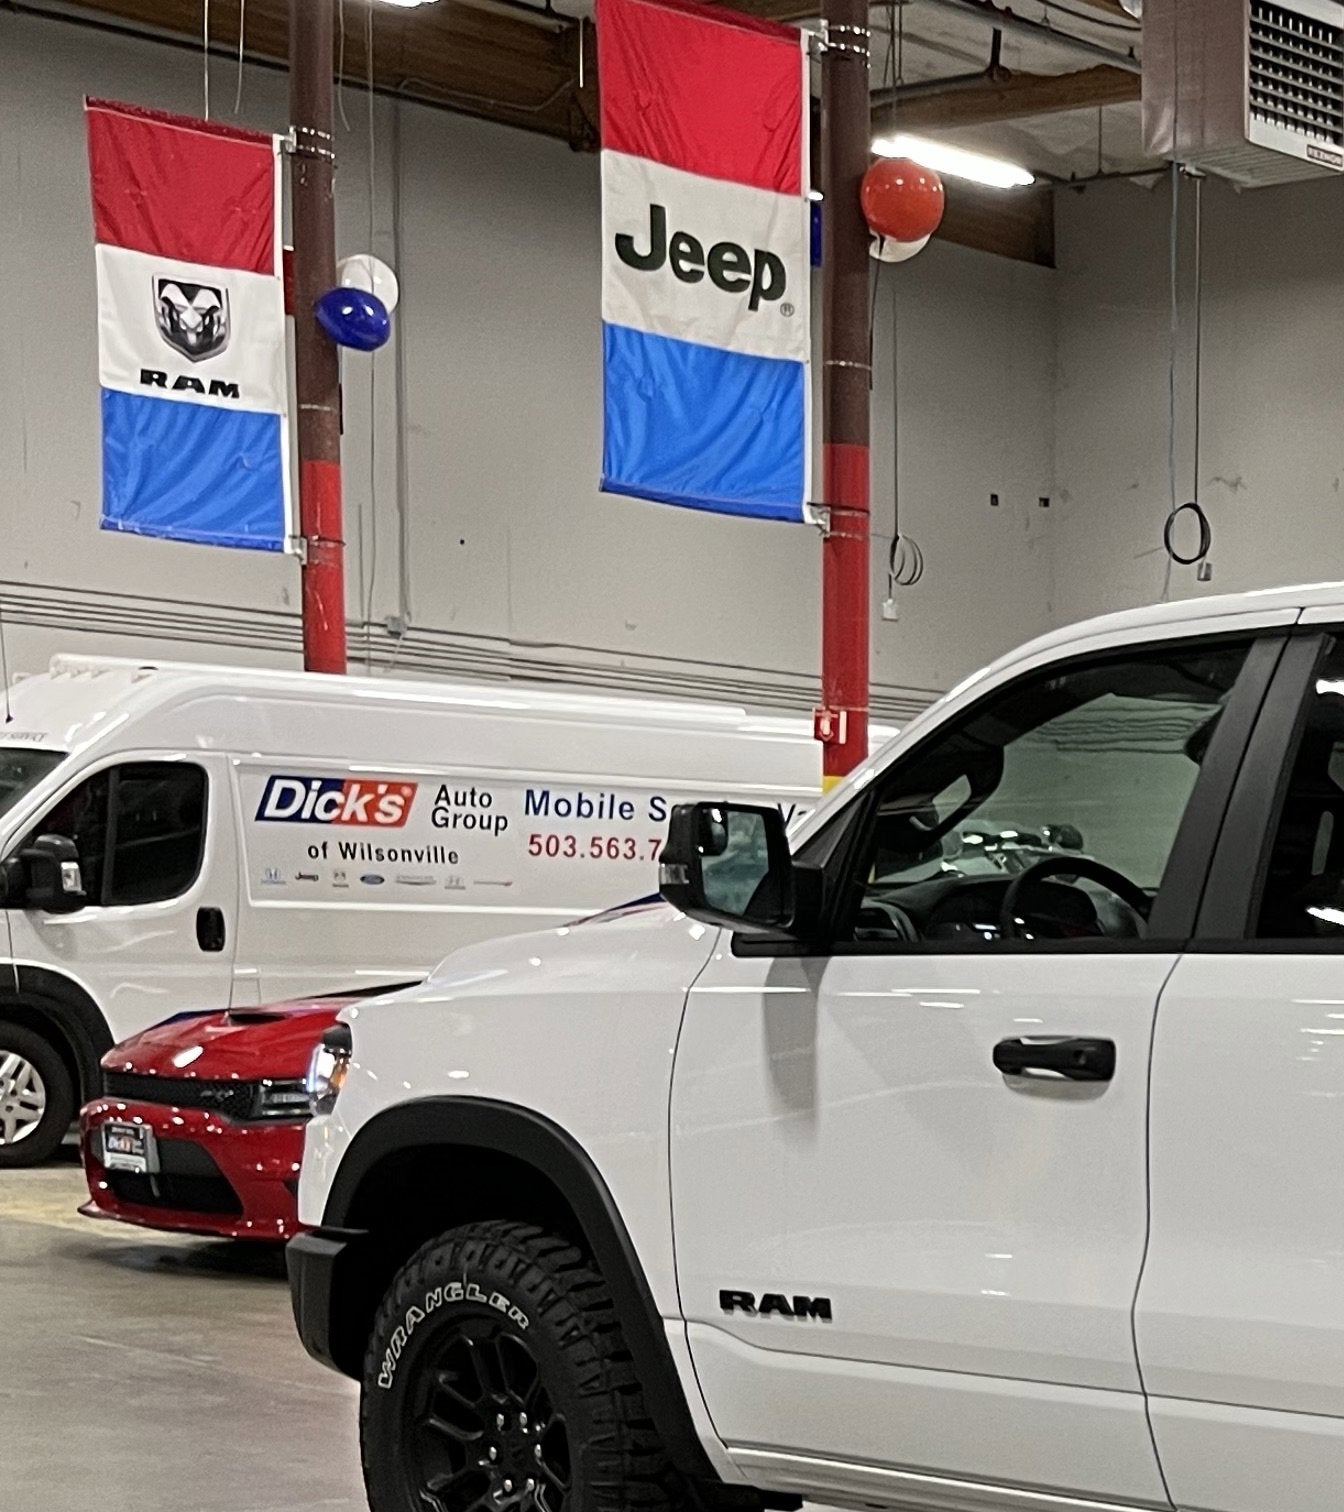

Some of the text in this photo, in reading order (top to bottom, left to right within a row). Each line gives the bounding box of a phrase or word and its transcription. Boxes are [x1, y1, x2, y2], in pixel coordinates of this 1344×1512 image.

[614, 203, 787, 312] Jeep
[140, 368, 240, 399] RAM
[263, 778, 406, 824] Dick's
[434, 784, 493, 809] Auto
[524, 789, 635, 821] Mobile
[431, 806, 508, 837] Group
[307, 841, 459, 864] of Wilsonville
[528, 833, 663, 861] 503.563.7
[718, 1289, 833, 1321] RAM
[377, 1281, 530, 1389] WRANGLER
